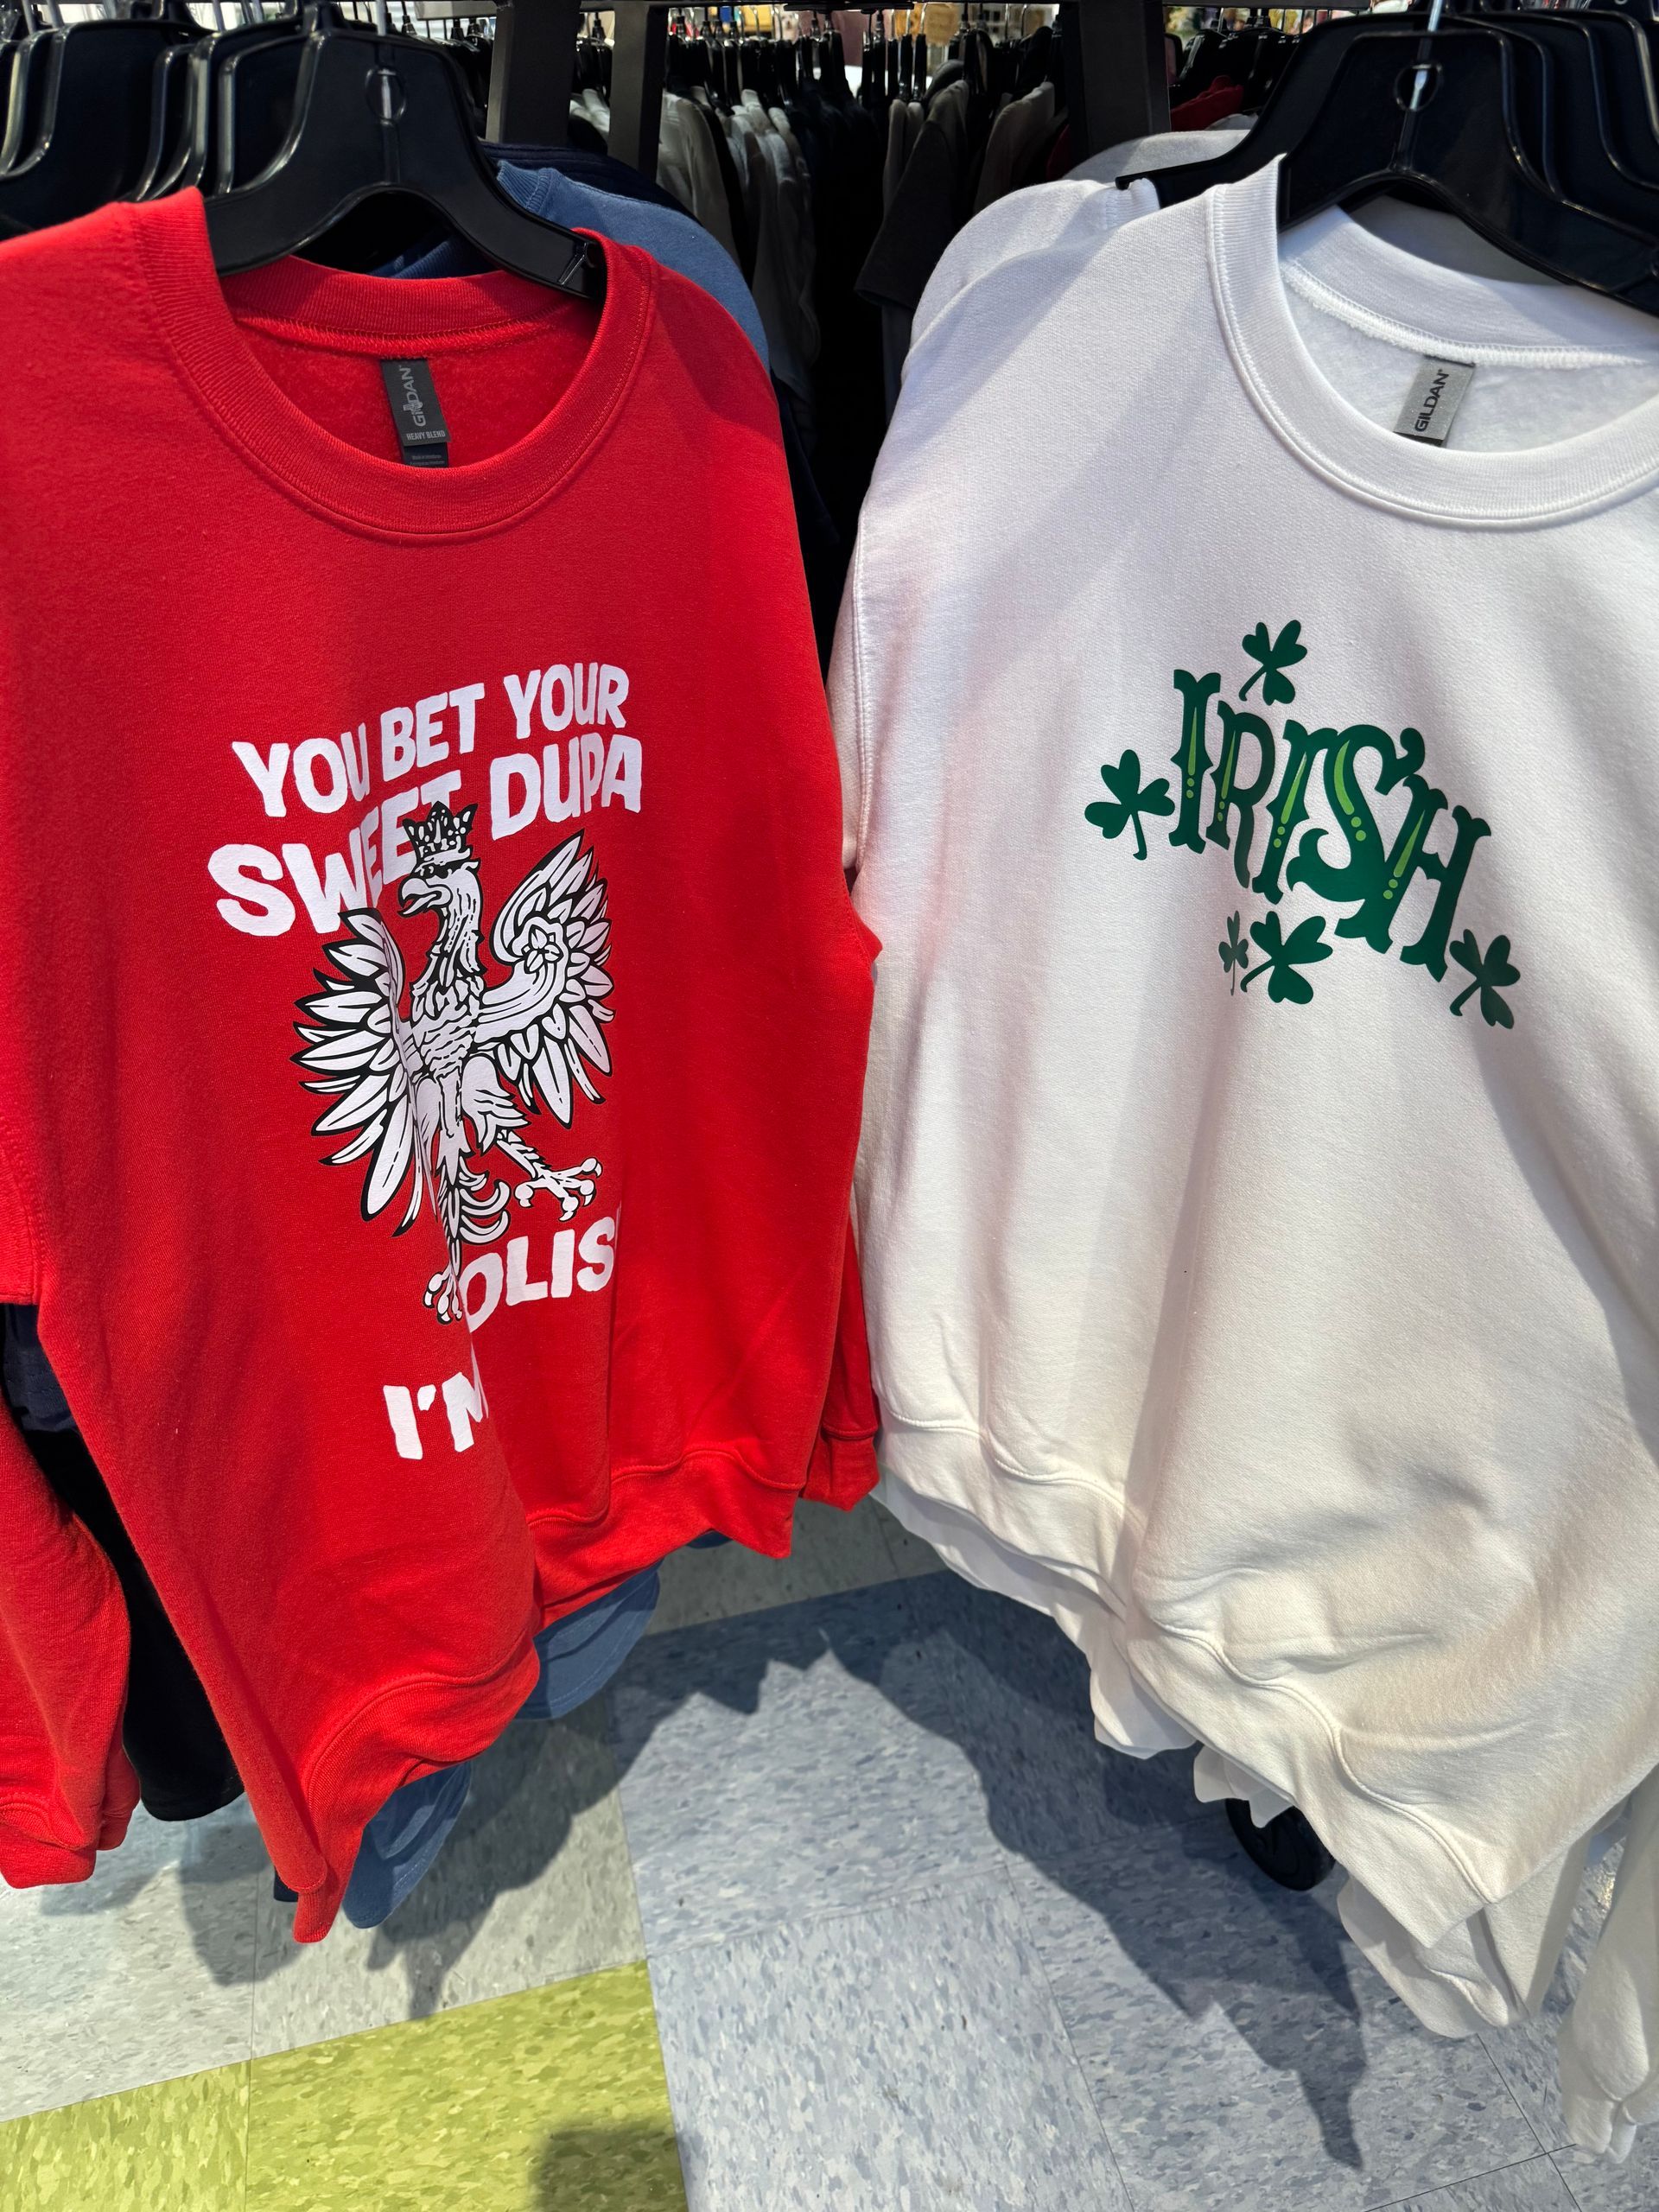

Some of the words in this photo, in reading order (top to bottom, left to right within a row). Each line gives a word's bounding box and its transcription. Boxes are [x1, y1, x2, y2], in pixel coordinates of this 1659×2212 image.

[406, 431, 425, 441] HEAVY
[426, 429, 446, 439] BLEND
[1414, 372, 1449, 431] GILDAN
[232, 723, 369, 817] YOU
[380, 683, 486, 781] BET
[503, 662, 629, 739] YOUR
[489, 732, 643, 840] DUPA
[1168, 669, 1491, 983] IRISH
[458, 1199, 622, 1333] OLIS
